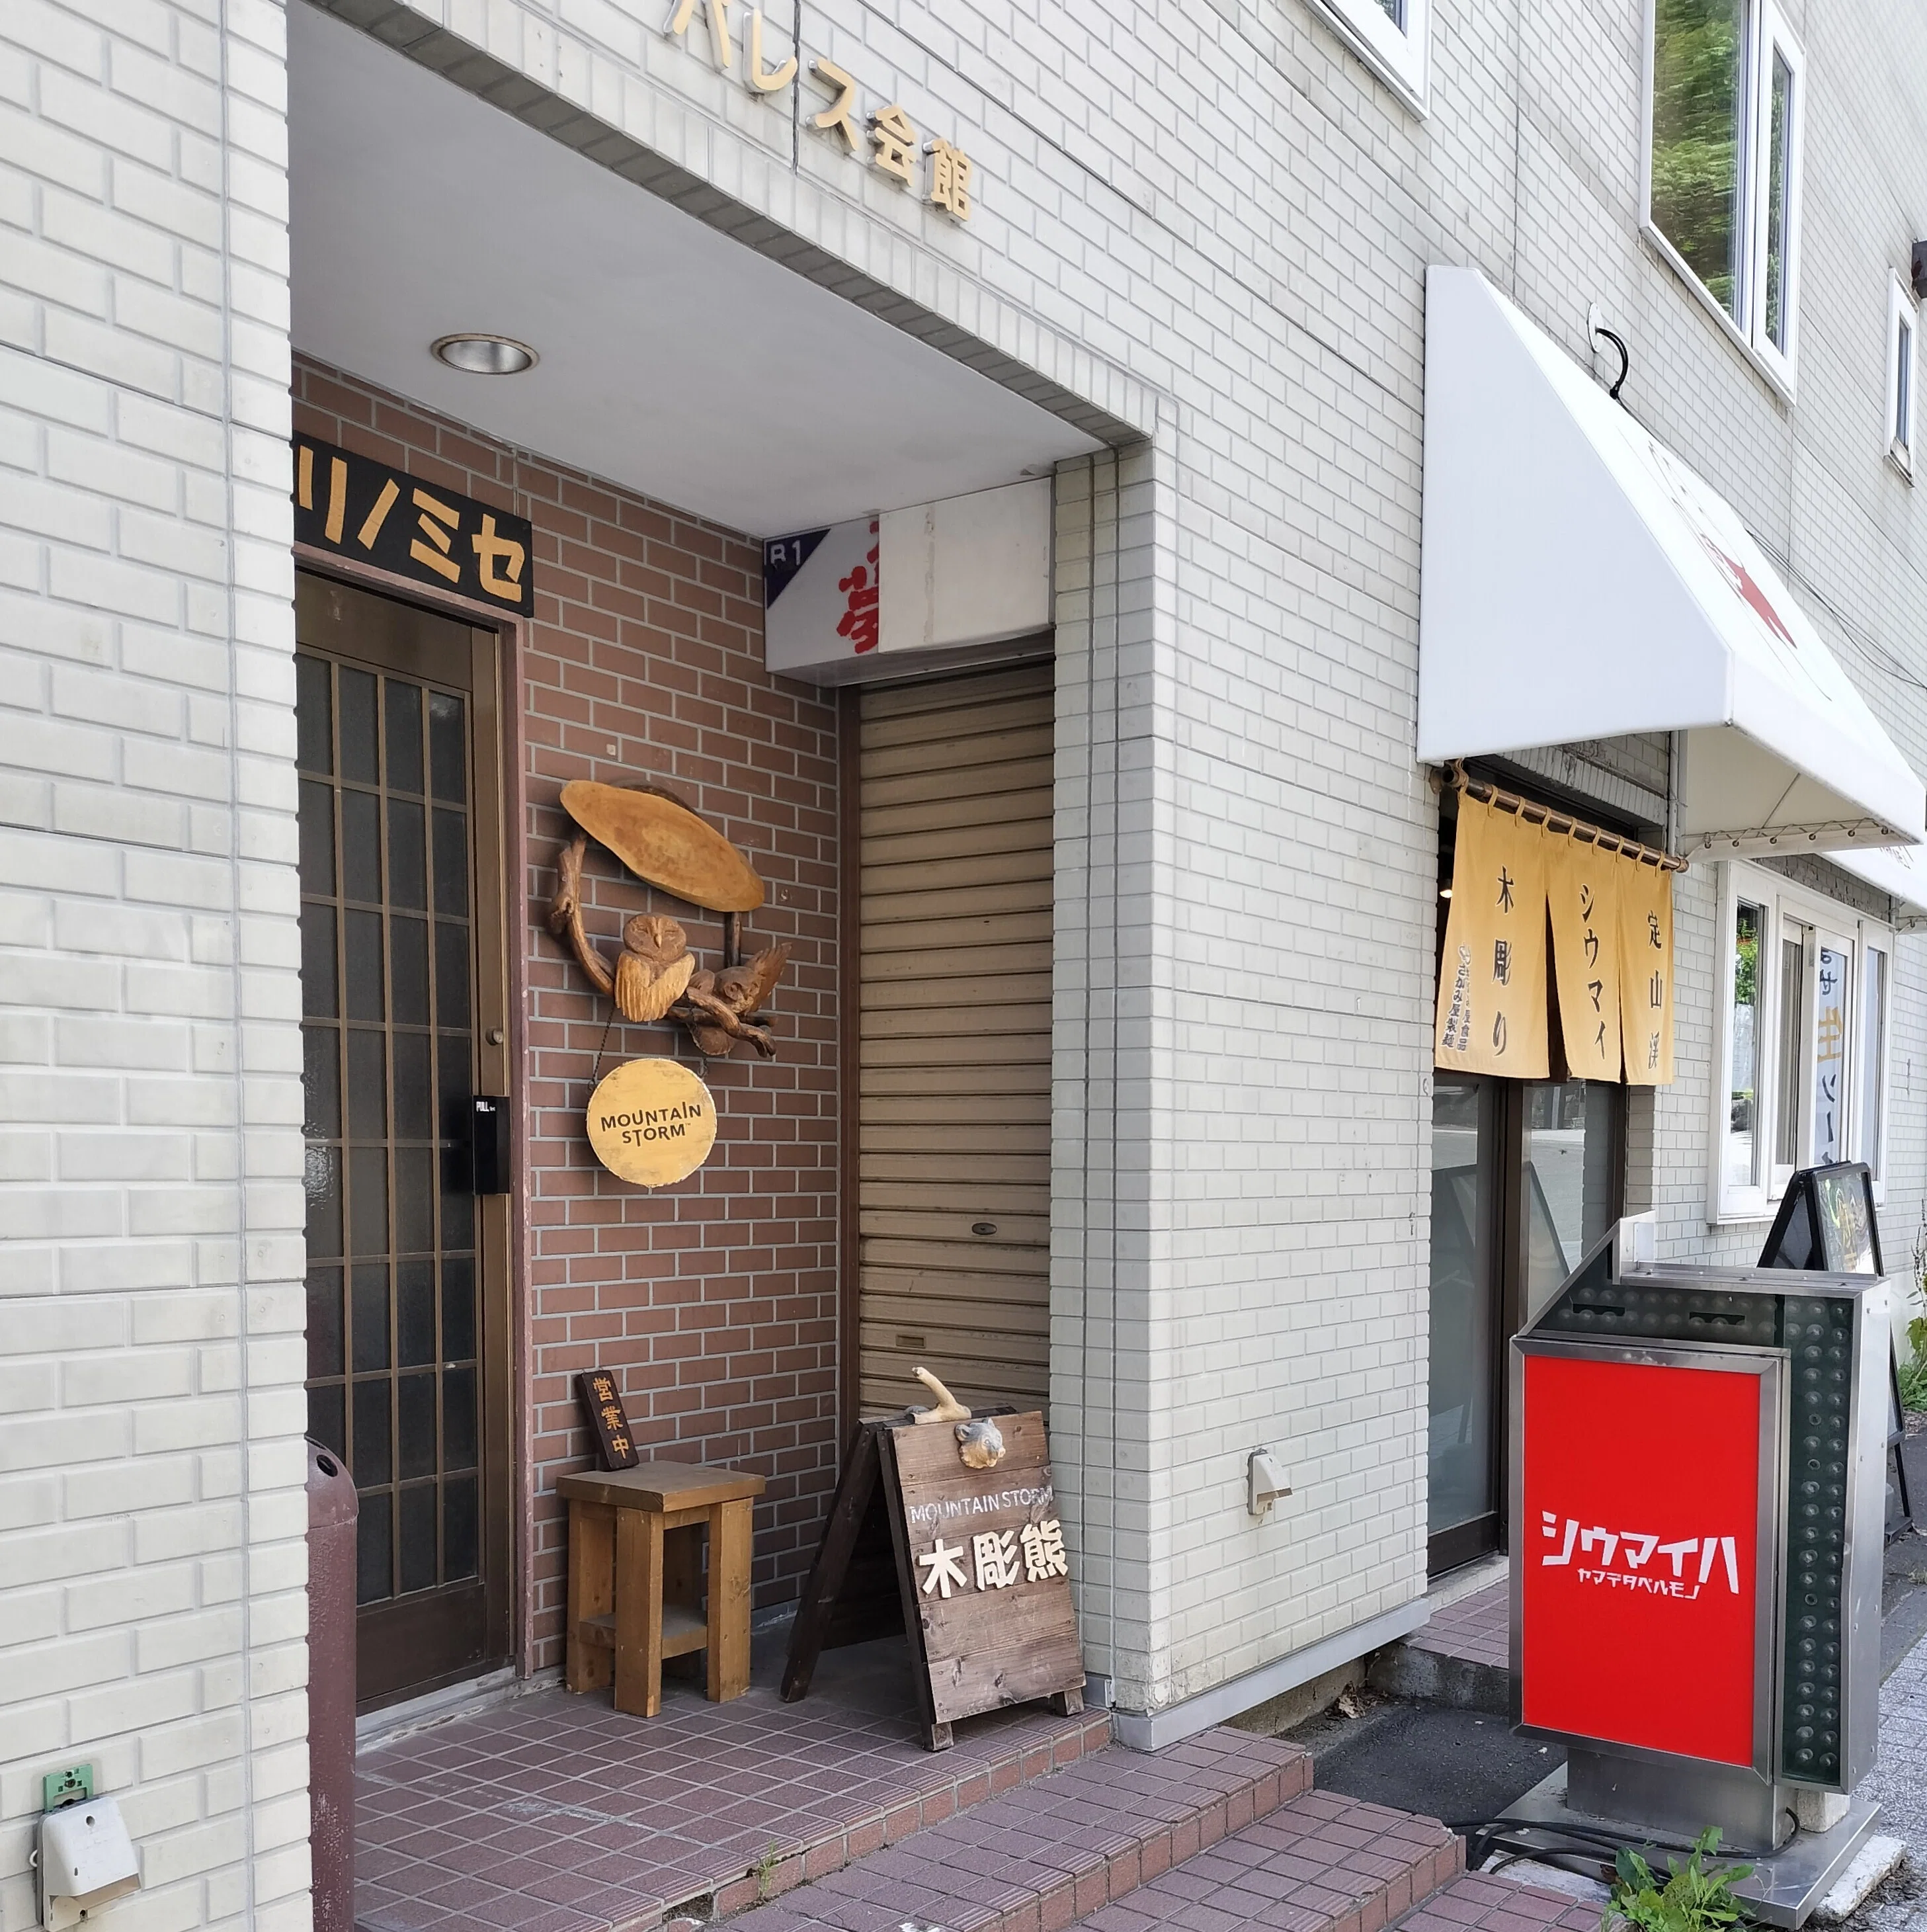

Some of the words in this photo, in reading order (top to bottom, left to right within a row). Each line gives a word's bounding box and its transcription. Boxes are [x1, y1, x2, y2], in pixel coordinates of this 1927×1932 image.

[1579, 884, 1606, 1060] シウマイ
[476, 1101, 489, 1113] PULL
[600, 1101, 702, 1132] MOUNTAIN
[593, 1376, 630, 1460] 営業中
[909, 1493, 1000, 1524] MOUNTAIN
[1002, 1485, 1055, 1508] STORM
[919, 1519, 1069, 1599] 木彫熊
[1541, 1510, 1739, 1595] シウマイハ
